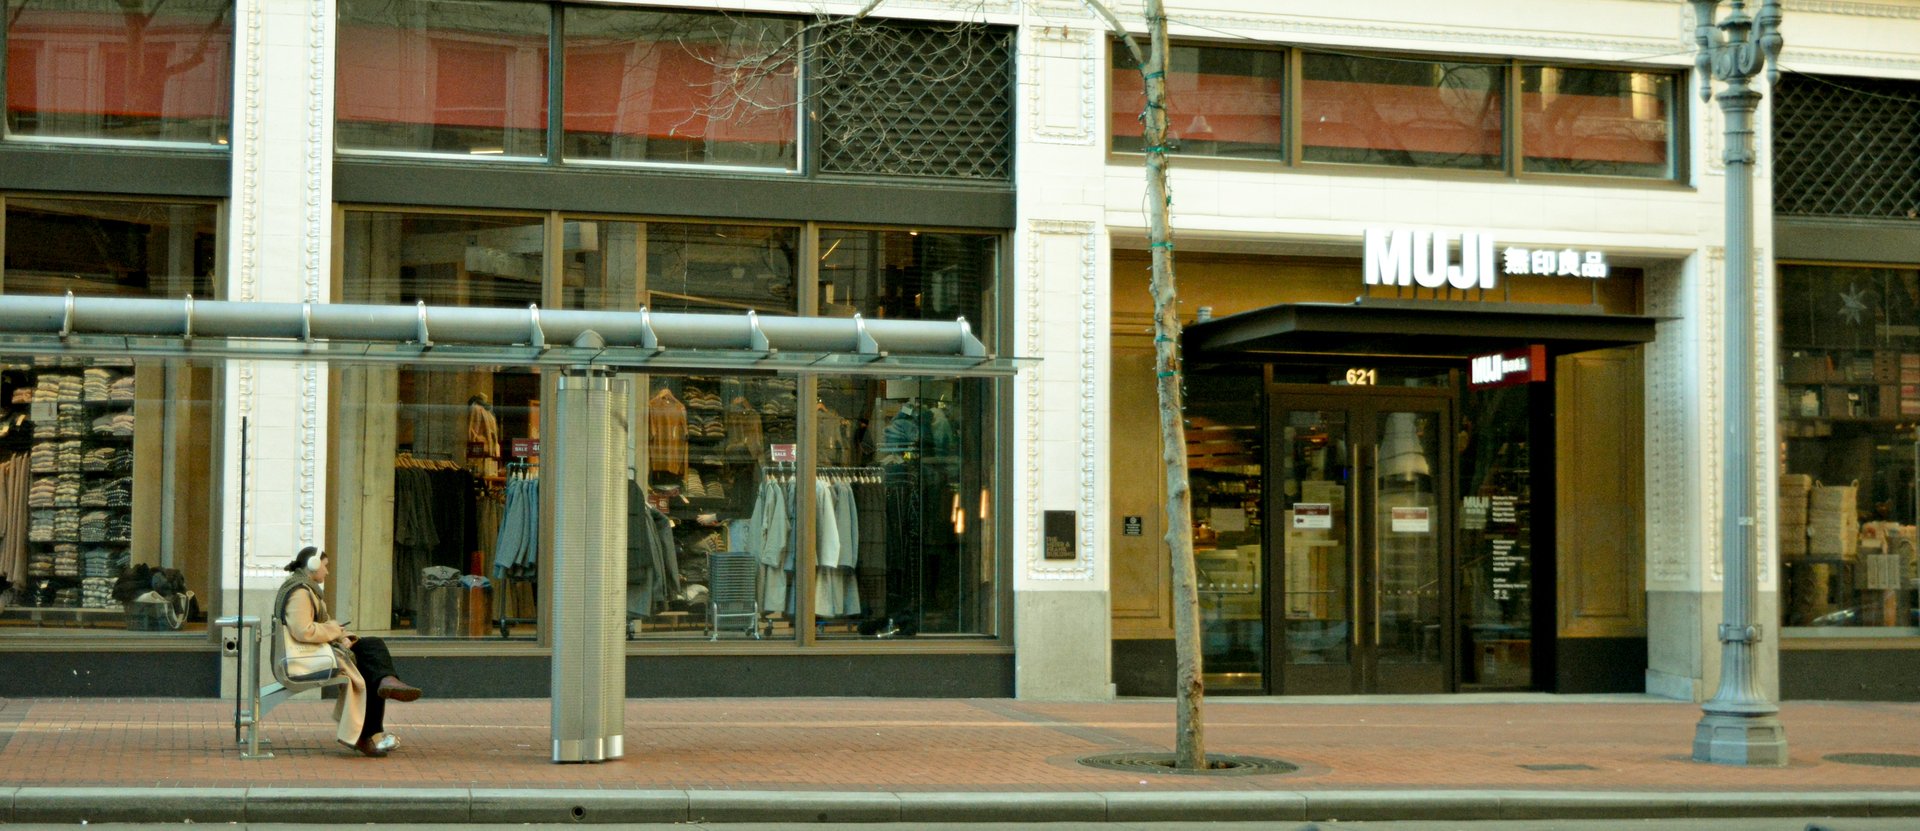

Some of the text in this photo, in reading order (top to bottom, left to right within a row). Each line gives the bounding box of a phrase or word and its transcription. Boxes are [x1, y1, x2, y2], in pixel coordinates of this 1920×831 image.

[1363, 228, 1495, 289] MUJI
[1503, 246, 1607, 278] 無印良品
[1346, 369, 1375, 385] 621
[1471, 354, 1502, 384] MUJI
[1463, 496, 1489, 508] MUJI
